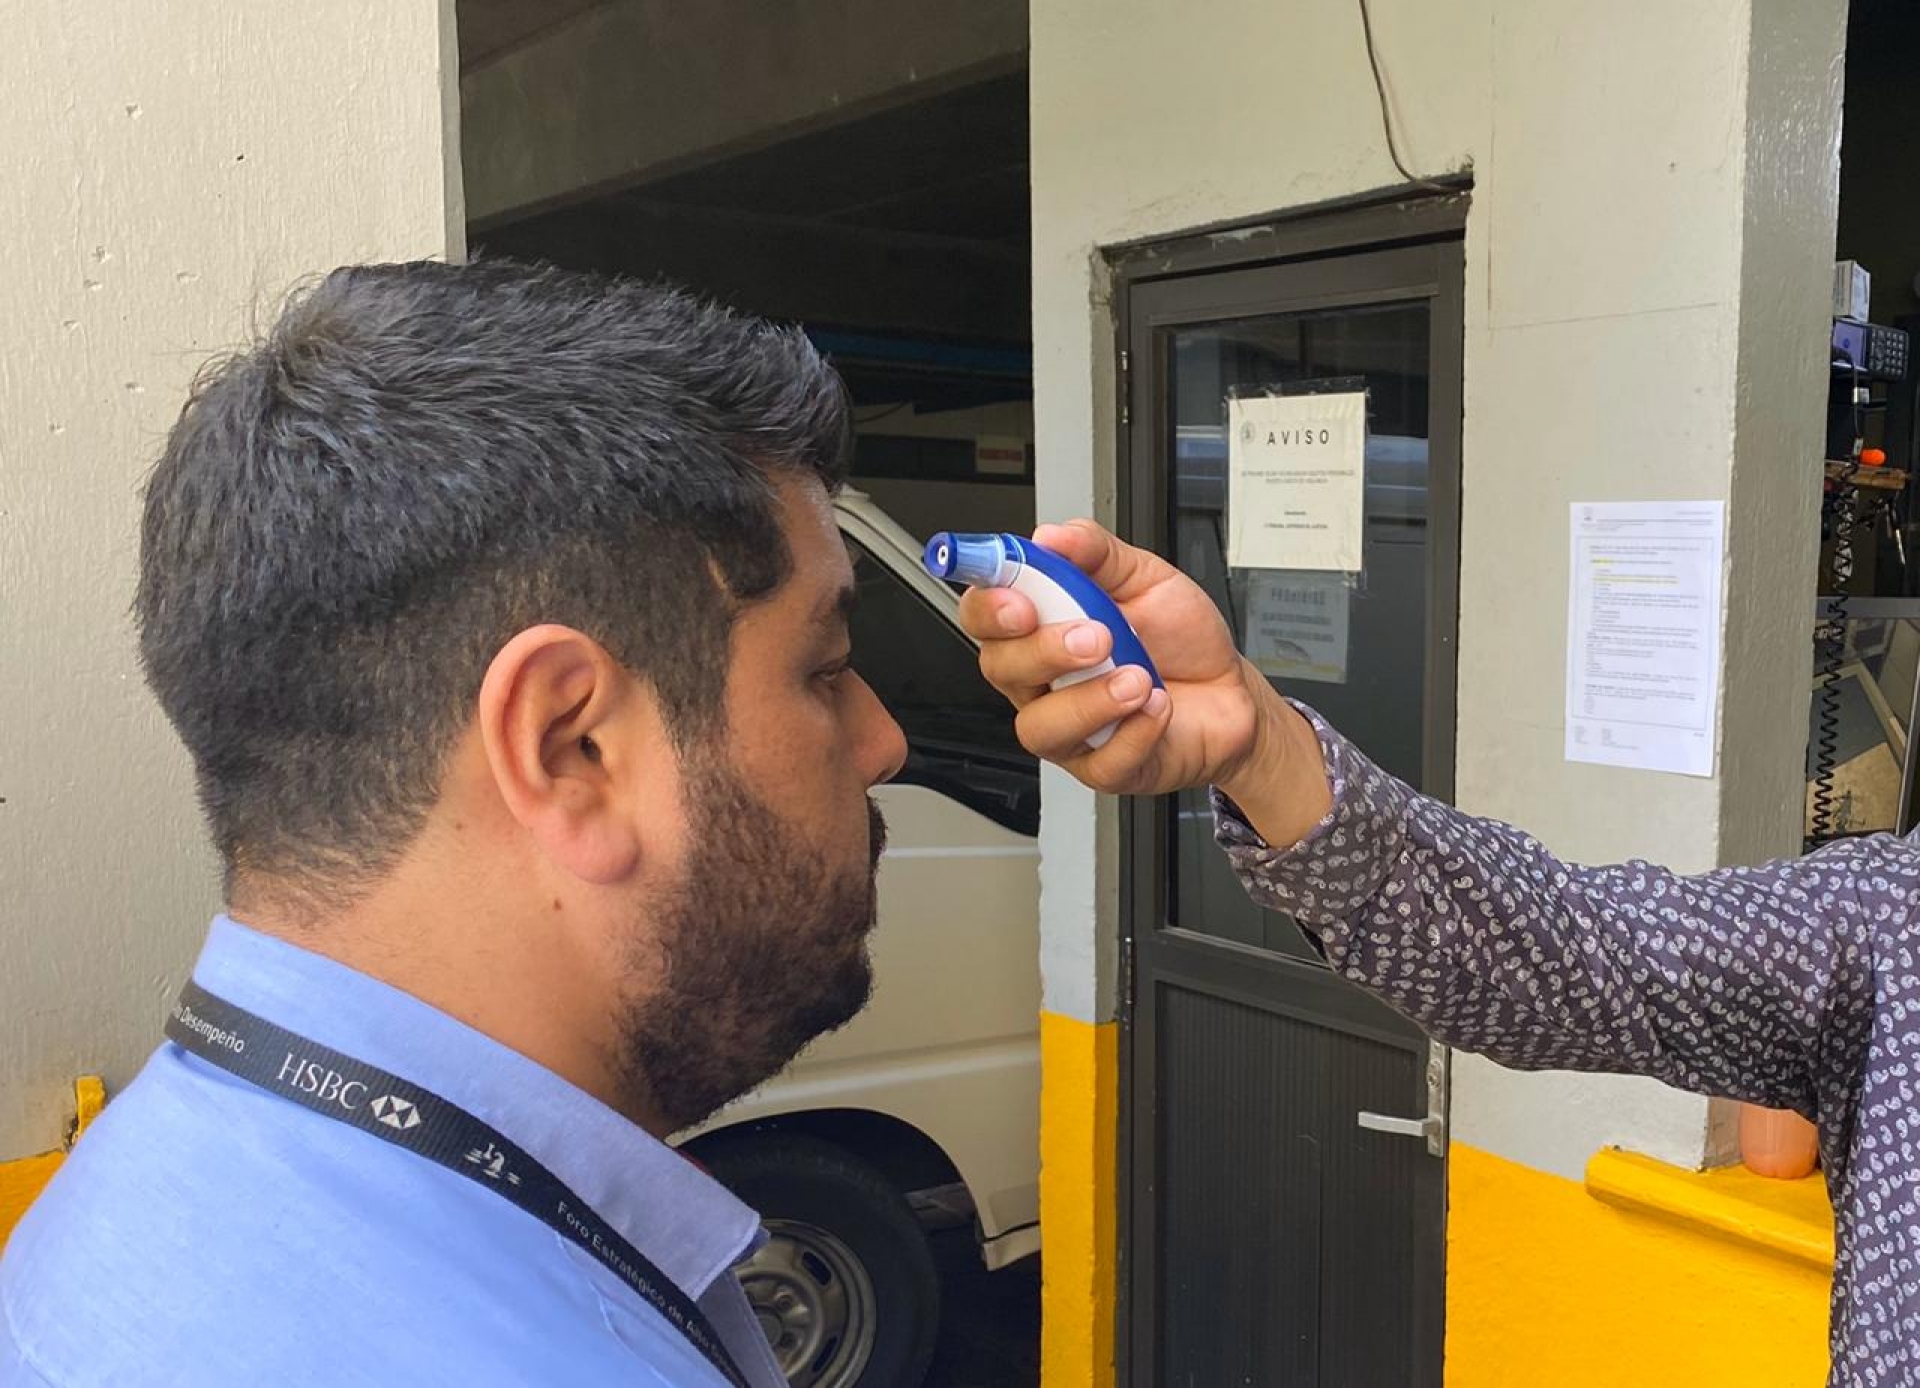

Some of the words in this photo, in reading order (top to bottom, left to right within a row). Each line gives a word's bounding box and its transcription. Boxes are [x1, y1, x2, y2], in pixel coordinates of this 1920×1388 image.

[1267, 429, 1330, 445] AVISO
[181, 1006, 244, 1053] Desempeño
[276, 1052, 368, 1110] HSBC
[557, 1200, 590, 1238] Foro
